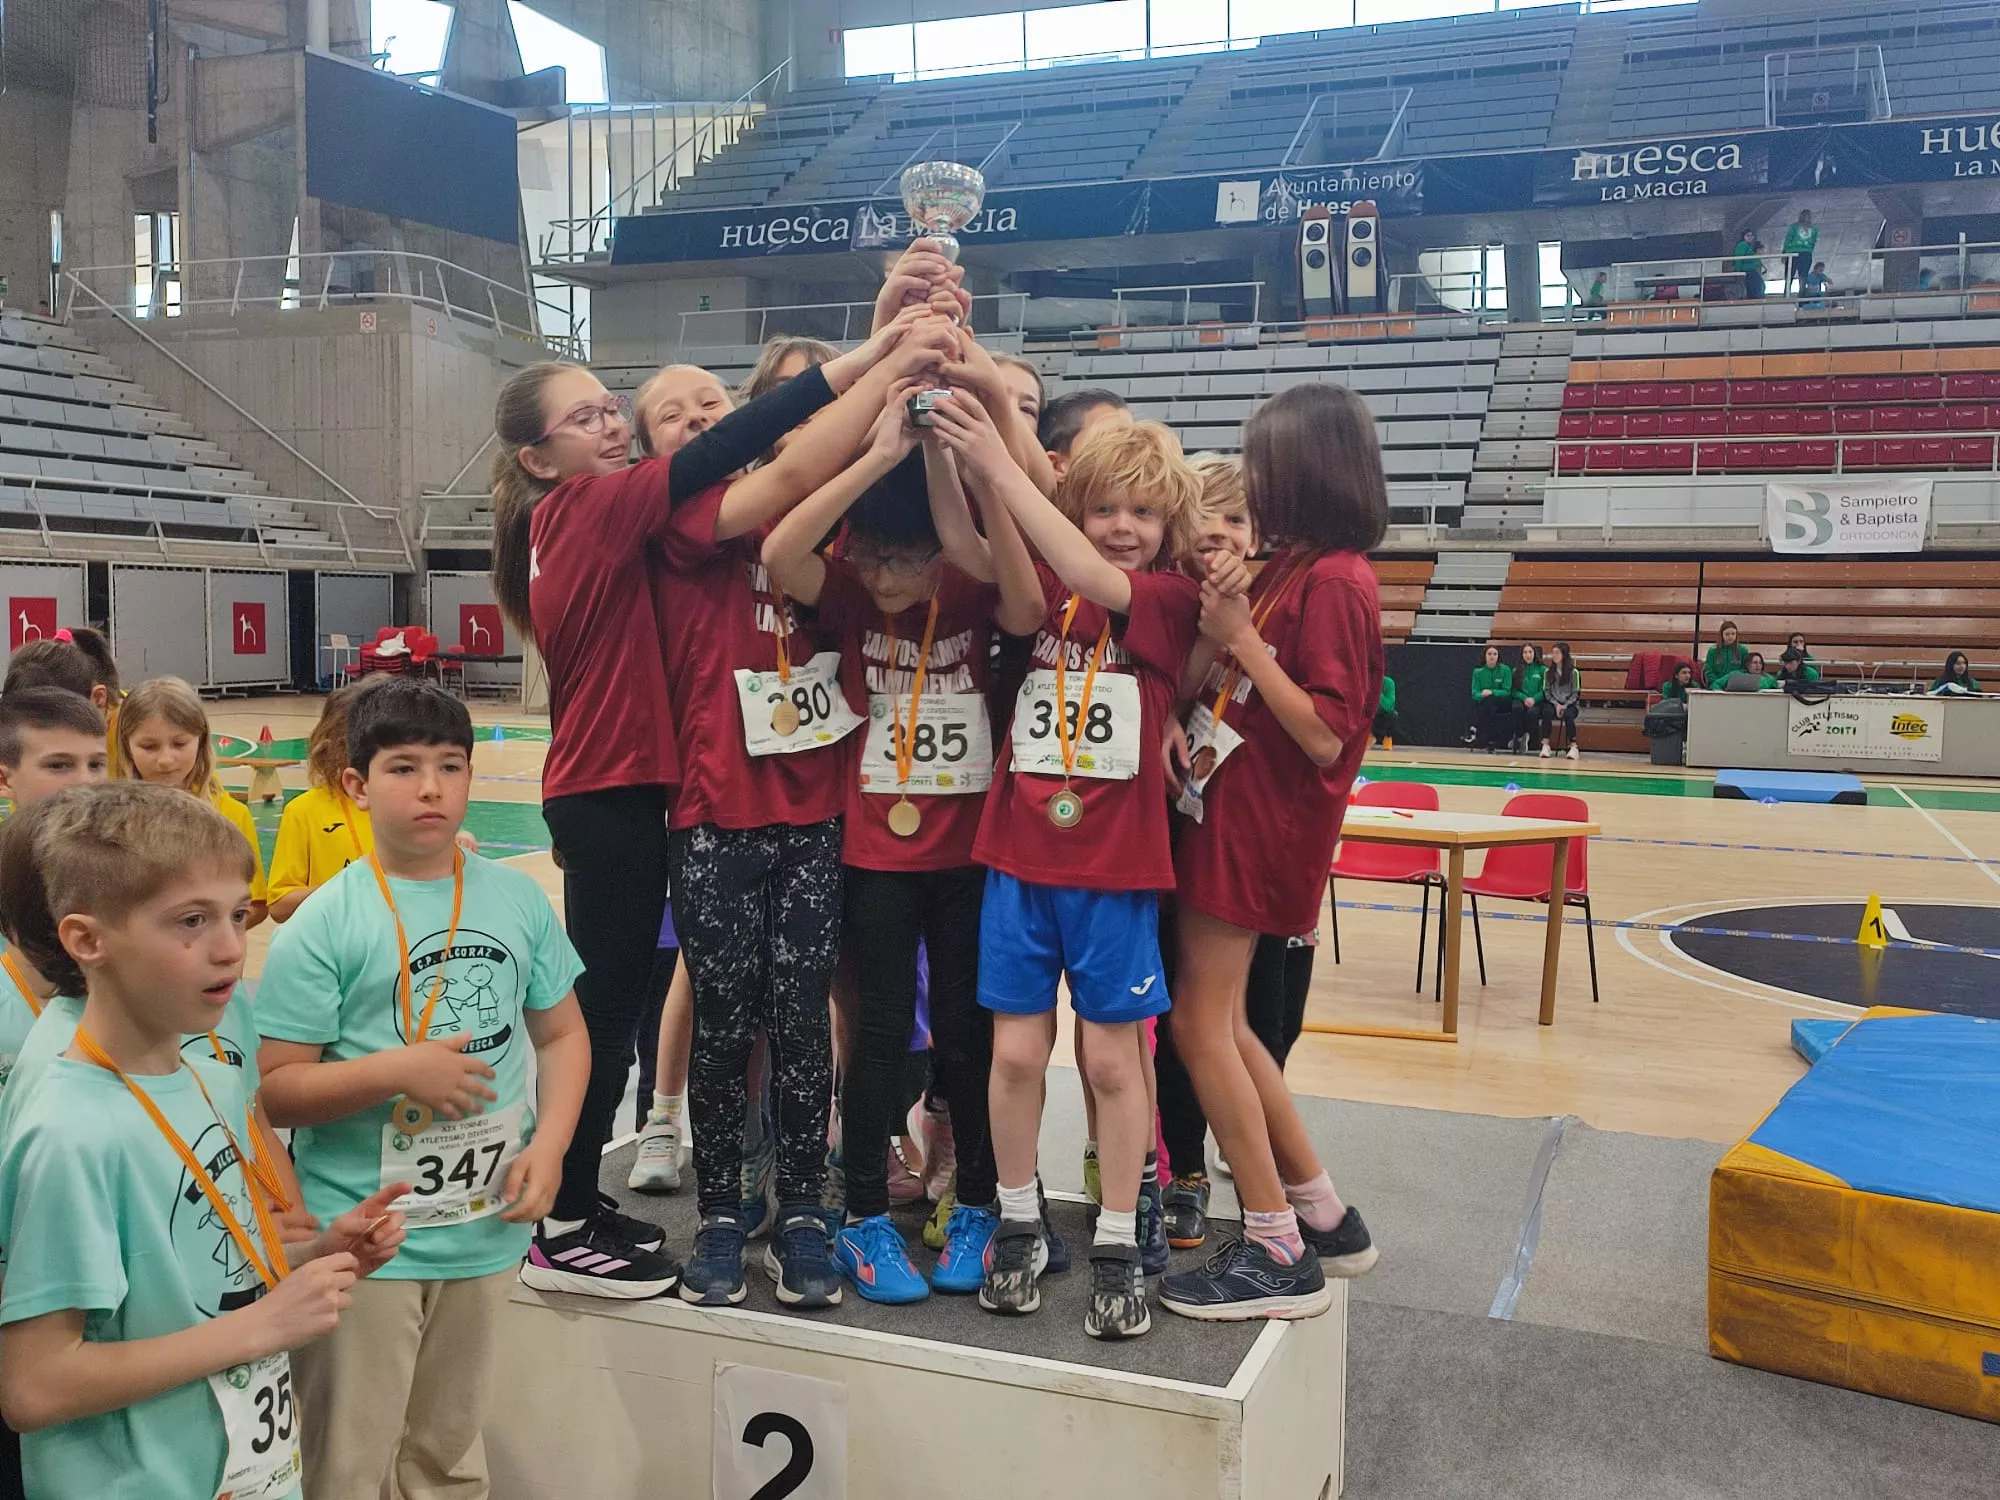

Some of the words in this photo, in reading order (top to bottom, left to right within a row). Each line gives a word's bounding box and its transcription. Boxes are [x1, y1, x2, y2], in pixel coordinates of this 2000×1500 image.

[1571, 143, 1742, 181] Huesca
[1266, 171, 1416, 199] Ayuntamiento
[1265, 202, 1289, 220] de
[719, 216, 849, 248] Huesca
[859, 213, 897, 240] La
[1840, 495, 1919, 510] Sampietro
[1840, 513, 1851, 526] &
[1856, 512, 1918, 528] Baptista
[1839, 530, 1920, 542] ORTODONCIA
[1791, 717, 1811, 733] CLUB
[883, 722, 968, 762] 385
[1869, 916, 1882, 939] 1
[440, 947, 493, 961] ALCORAZ
[413, 1140, 506, 1196] 347
[742, 1411, 814, 1500] 2
